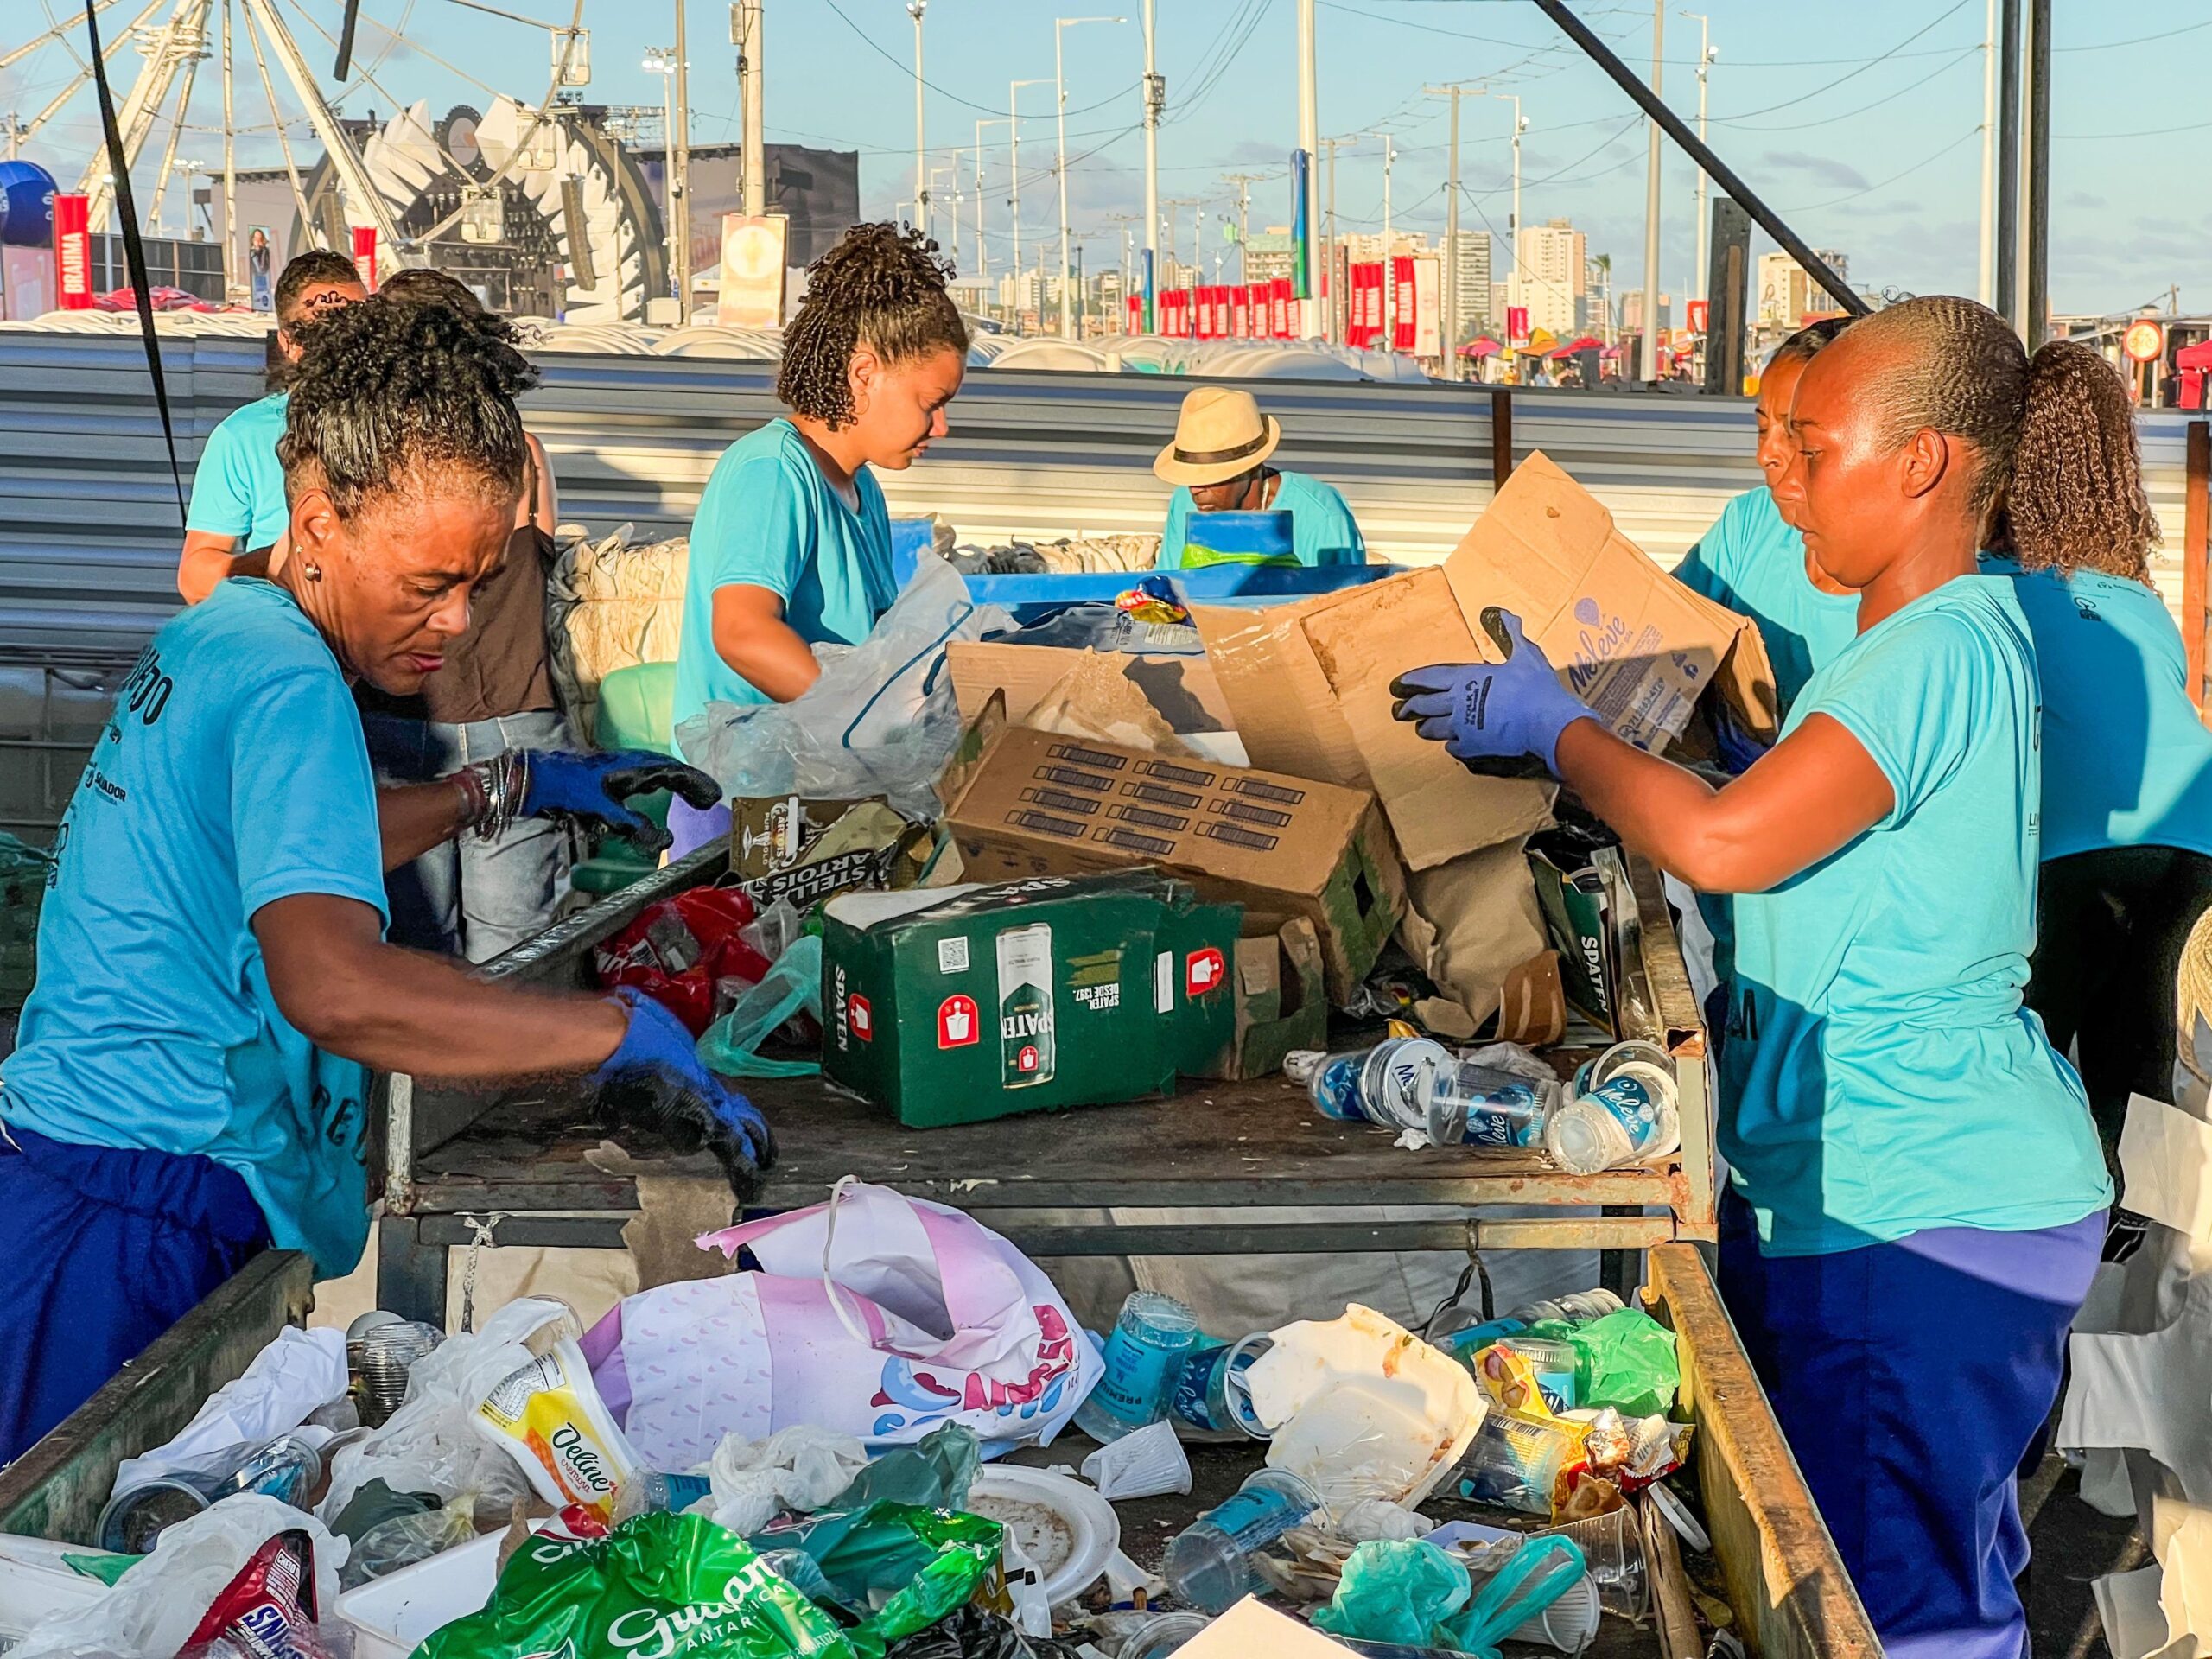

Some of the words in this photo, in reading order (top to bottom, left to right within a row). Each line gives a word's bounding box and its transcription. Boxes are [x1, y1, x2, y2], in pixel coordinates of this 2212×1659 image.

[61, 232, 86, 295] BRAHMA
[777, 816, 785, 858] ARTOIS
[772, 852, 872, 892] ARTOIS
[772, 866, 867, 900] STELLA
[835, 963, 849, 1052] SPATEN
[1095, 982, 1119, 995] DESDE
[1595, 1088, 1640, 1135] Meleve
[561, 1459, 591, 1495] cremosa
